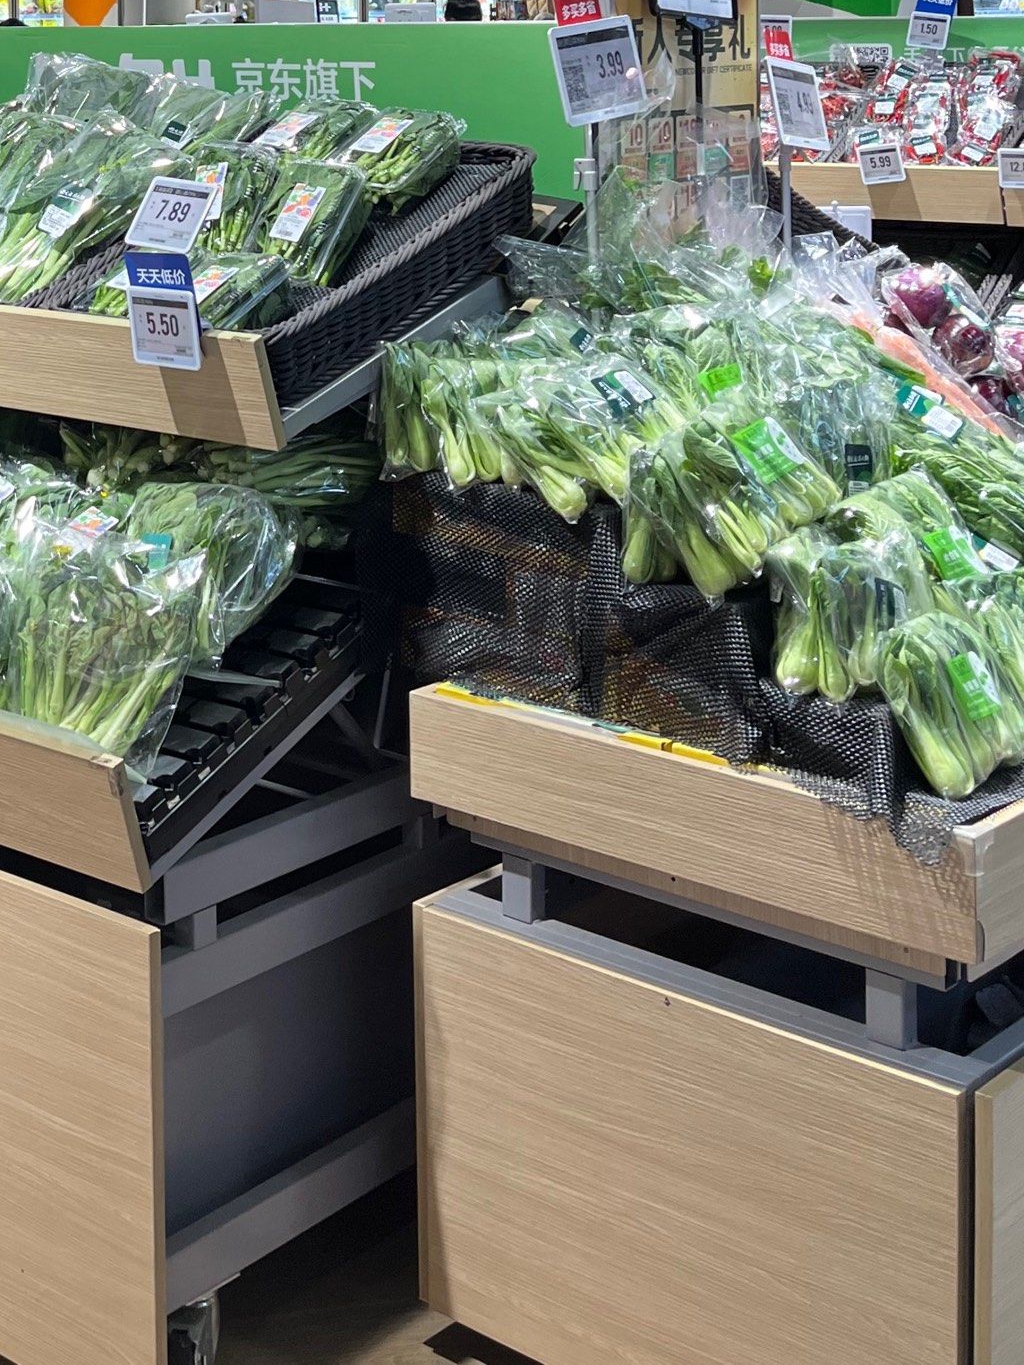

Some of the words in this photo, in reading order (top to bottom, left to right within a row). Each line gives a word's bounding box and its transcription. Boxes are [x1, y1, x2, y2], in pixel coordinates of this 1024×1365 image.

[561, 0, 597, 21] 多买多省
[920, 22, 938, 35] 1.50
[595, 50, 625, 79] 3.99
[231, 57, 376, 103] 京东旗下
[869, 155, 892, 169] 5.99
[1009, 161, 1024, 173] 12.
[155, 199, 191, 223] 7.89
[136, 268, 186, 286] 天天低价
[145, 311, 180, 338] 5.50
